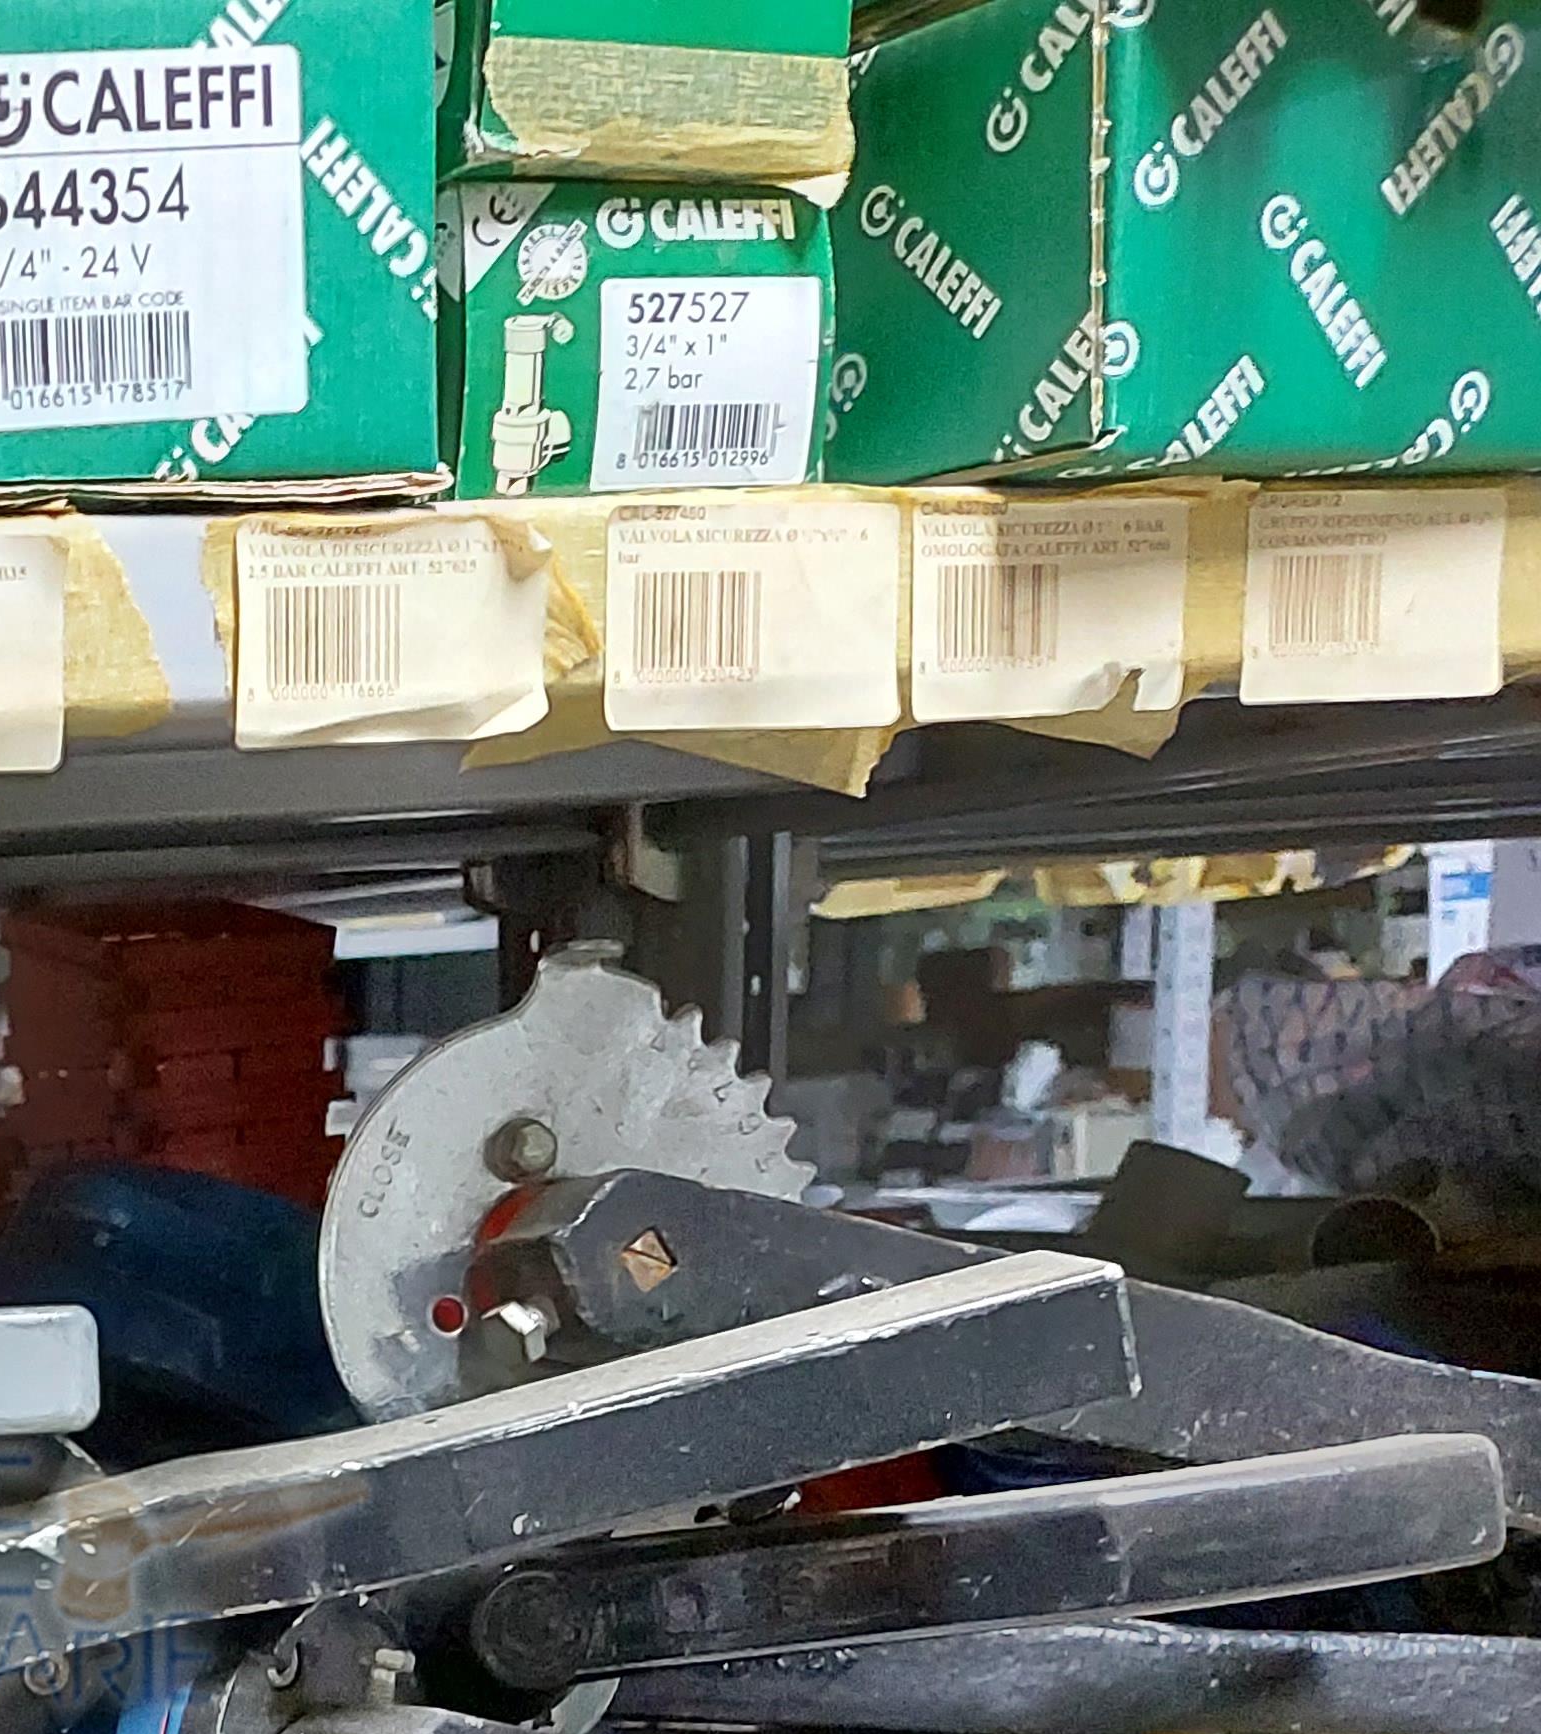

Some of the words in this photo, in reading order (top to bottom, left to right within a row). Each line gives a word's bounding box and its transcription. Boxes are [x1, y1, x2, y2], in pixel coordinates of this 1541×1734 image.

[42, 63, 273, 136] CALEFFI
[1170, 7, 1290, 158] CALEFFI
[1378, 70, 1496, 217] CALEFFI
[300, 116, 430, 279] CALEFFI
[650, 197, 796, 242] CALEFFI
[81, 250, 120, 279] 24
[132, 243, 152, 275] V
[893, 217, 1004, 340] CALEFFI
[60, 295, 97, 311] ITEM
[102, 294, 132, 309] BAR
[138, 290, 184, 307] CODE
[626, 291, 751, 325] 527527
[1288, 237, 1389, 391] CALEFFI
[625, 334, 677, 360] 3/4"
[684, 341, 697, 357] x
[707, 334, 728, 356] 1"
[10, 383, 92, 410] 016615
[107, 379, 185, 403] 178517
[624, 368, 660, 392] 2,7
[667, 367, 703, 390] bar
[616, 453, 627, 470] 8
[638, 451, 701, 469] 016615
[709, 448, 770, 467] 012996
[619, 528, 693, 544] VALVOLA
[696, 528, 783, 544] SICUREZZA
[921, 522, 993, 538] VALVOLA
[273, 562, 307, 578] BAR
[311, 560, 383, 577] CALEFFI
